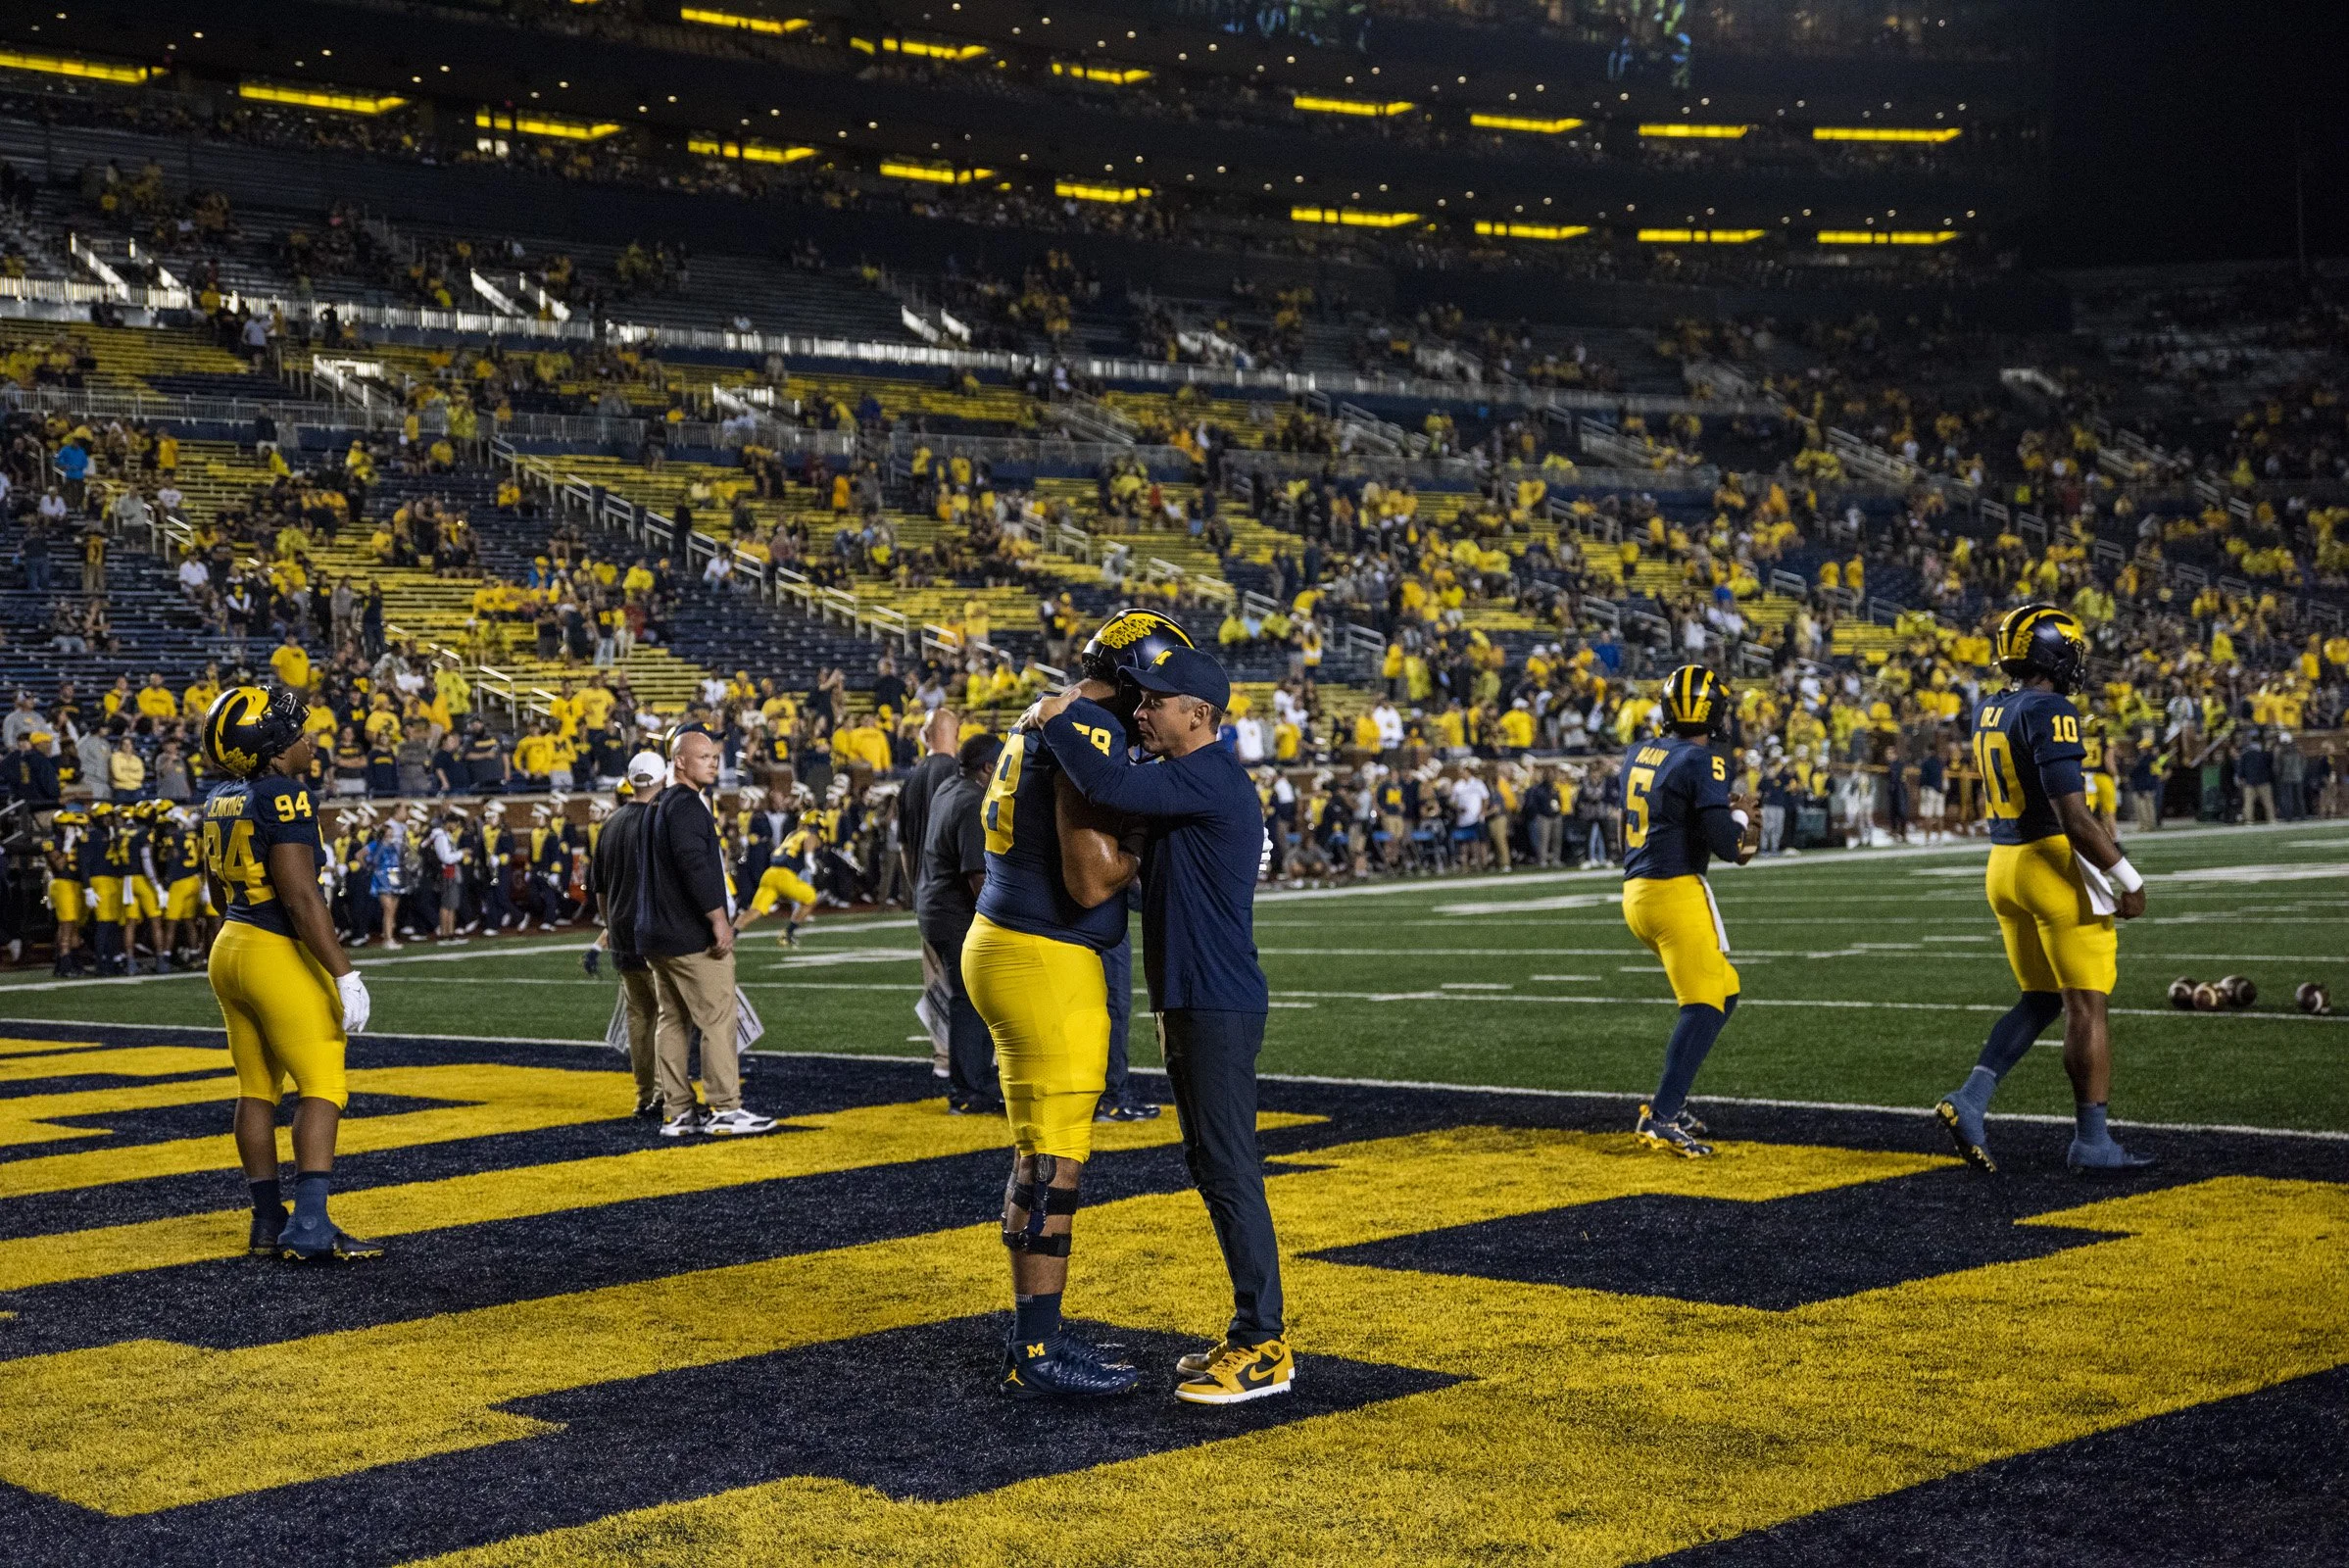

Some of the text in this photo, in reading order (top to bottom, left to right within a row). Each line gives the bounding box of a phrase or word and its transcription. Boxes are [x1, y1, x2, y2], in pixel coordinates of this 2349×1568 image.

[1981, 707, 2004, 727] ORJI
[2051, 714, 2079, 743] 10
[1711, 755, 1726, 782] 5
[1973, 730, 2027, 819] 10
[207, 795, 247, 818] JENKINS
[274, 791, 313, 822] 94
[1626, 765, 1656, 849] 5
[203, 819, 275, 906] 94
[1026, 1343, 1046, 1357] M
